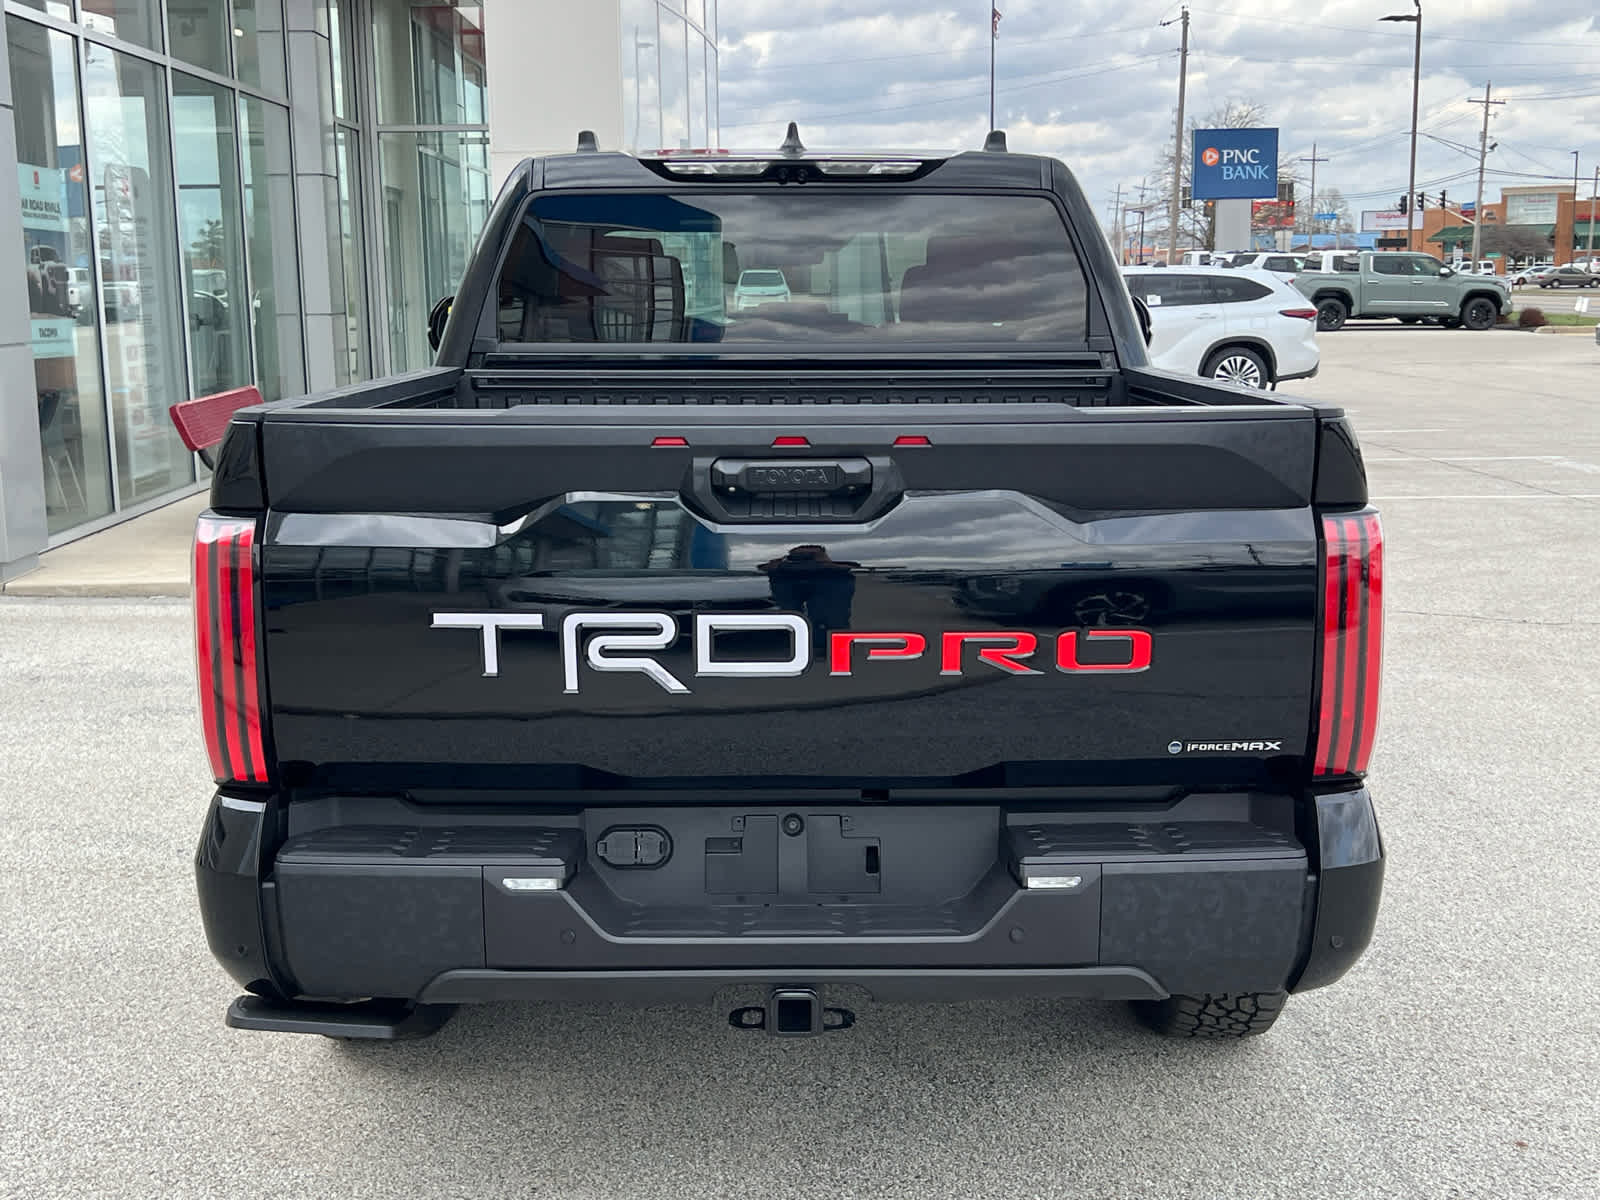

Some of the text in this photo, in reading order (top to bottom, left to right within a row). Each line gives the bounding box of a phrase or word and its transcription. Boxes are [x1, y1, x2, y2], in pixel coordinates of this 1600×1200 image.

[1221, 148, 1260, 164] PNC
[1221, 164, 1270, 181] BANK
[754, 468, 829, 485] TOYOTA
[431, 612, 1153, 694] TRD PRO
